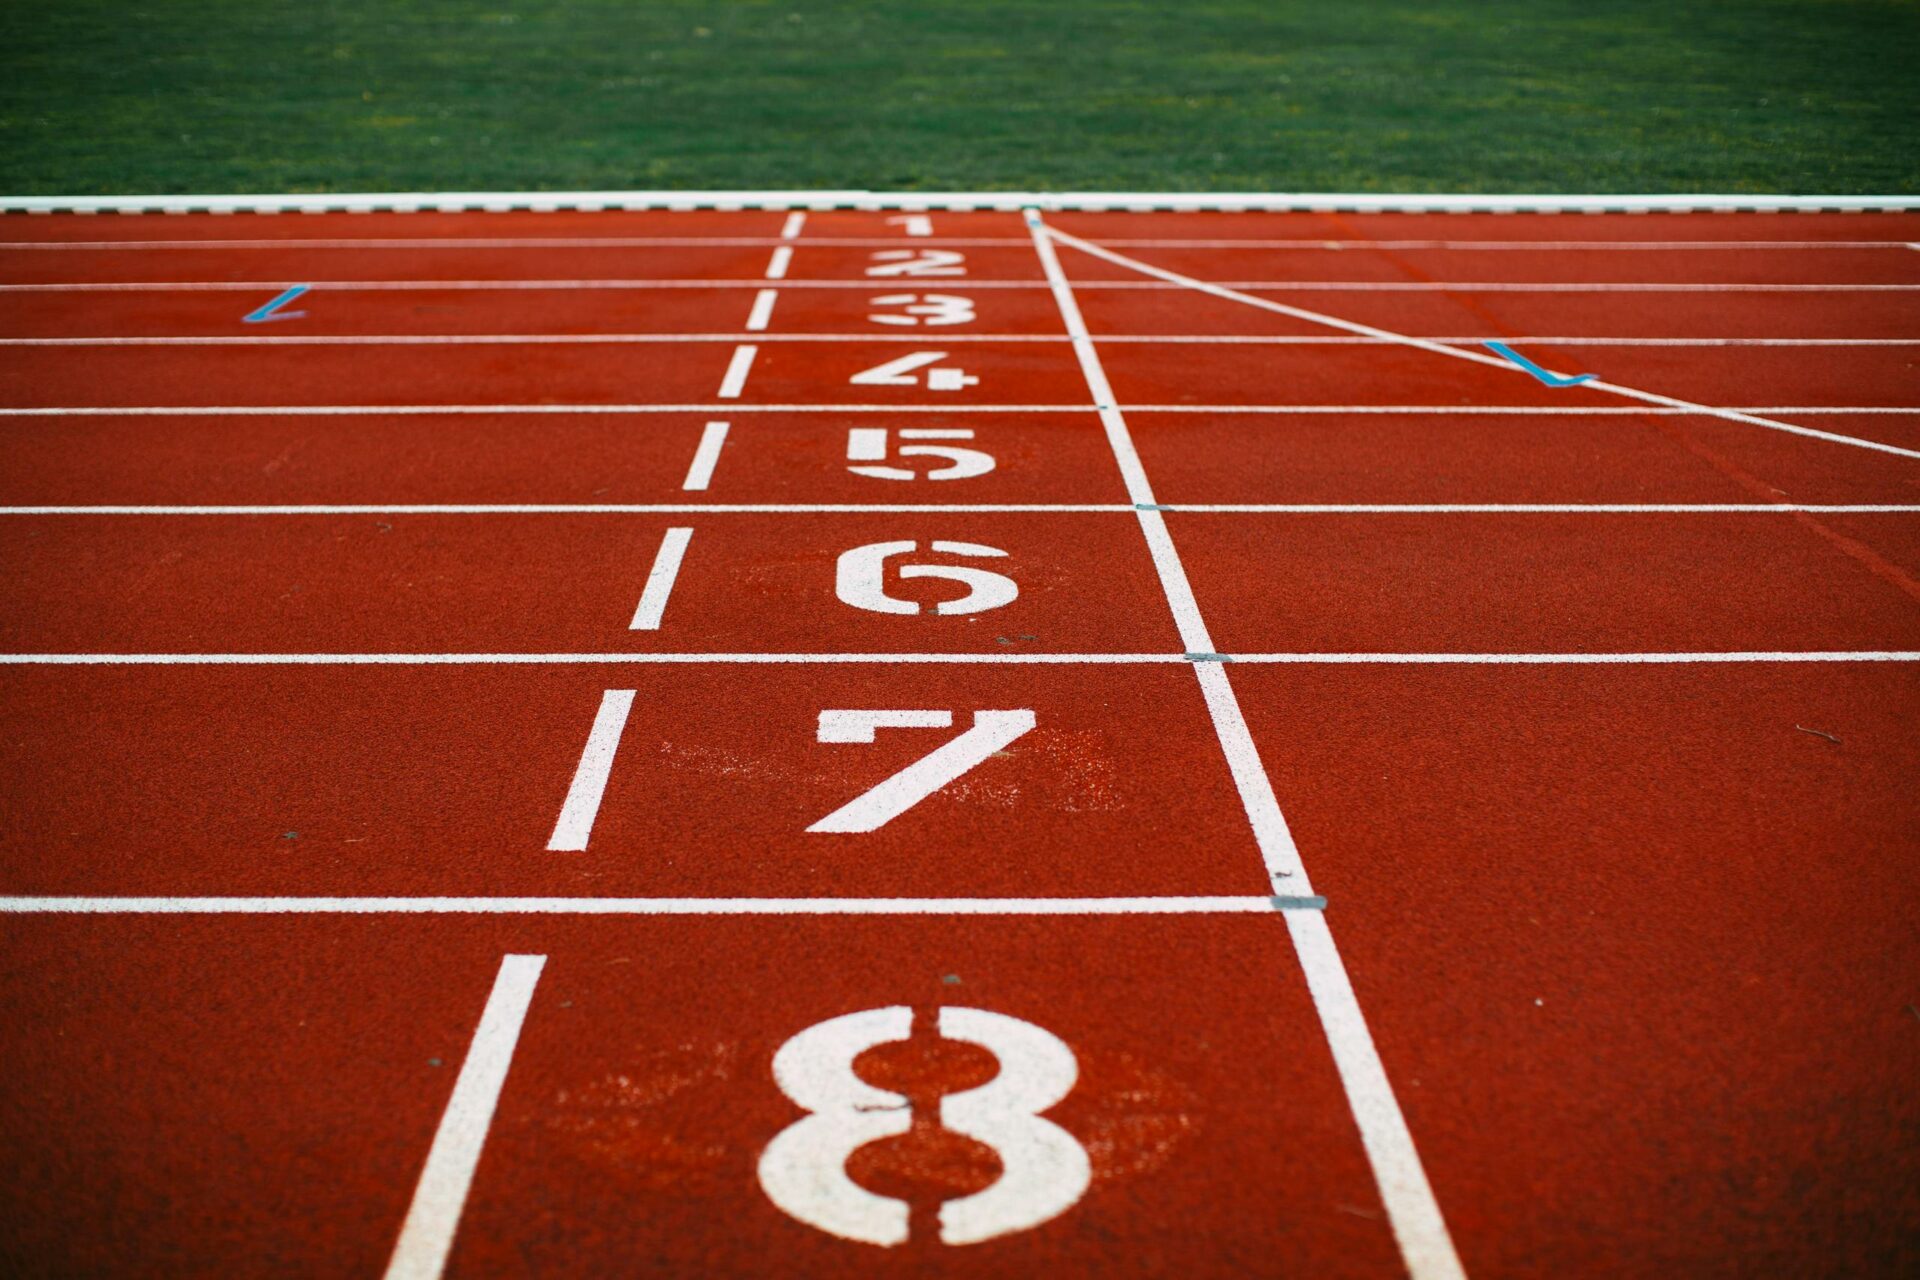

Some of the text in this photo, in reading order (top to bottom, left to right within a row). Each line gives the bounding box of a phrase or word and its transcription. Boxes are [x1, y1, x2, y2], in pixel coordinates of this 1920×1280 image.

[886, 215, 933, 237] 1
[865, 249, 967, 277] 2
[868, 294, 977, 327] 3
[850, 352, 980, 391] 4
[847, 428, 996, 482] 5
[836, 541, 1019, 617] 6
[806, 709, 1037, 834] 7
[758, 1005, 1093, 1248] 8
